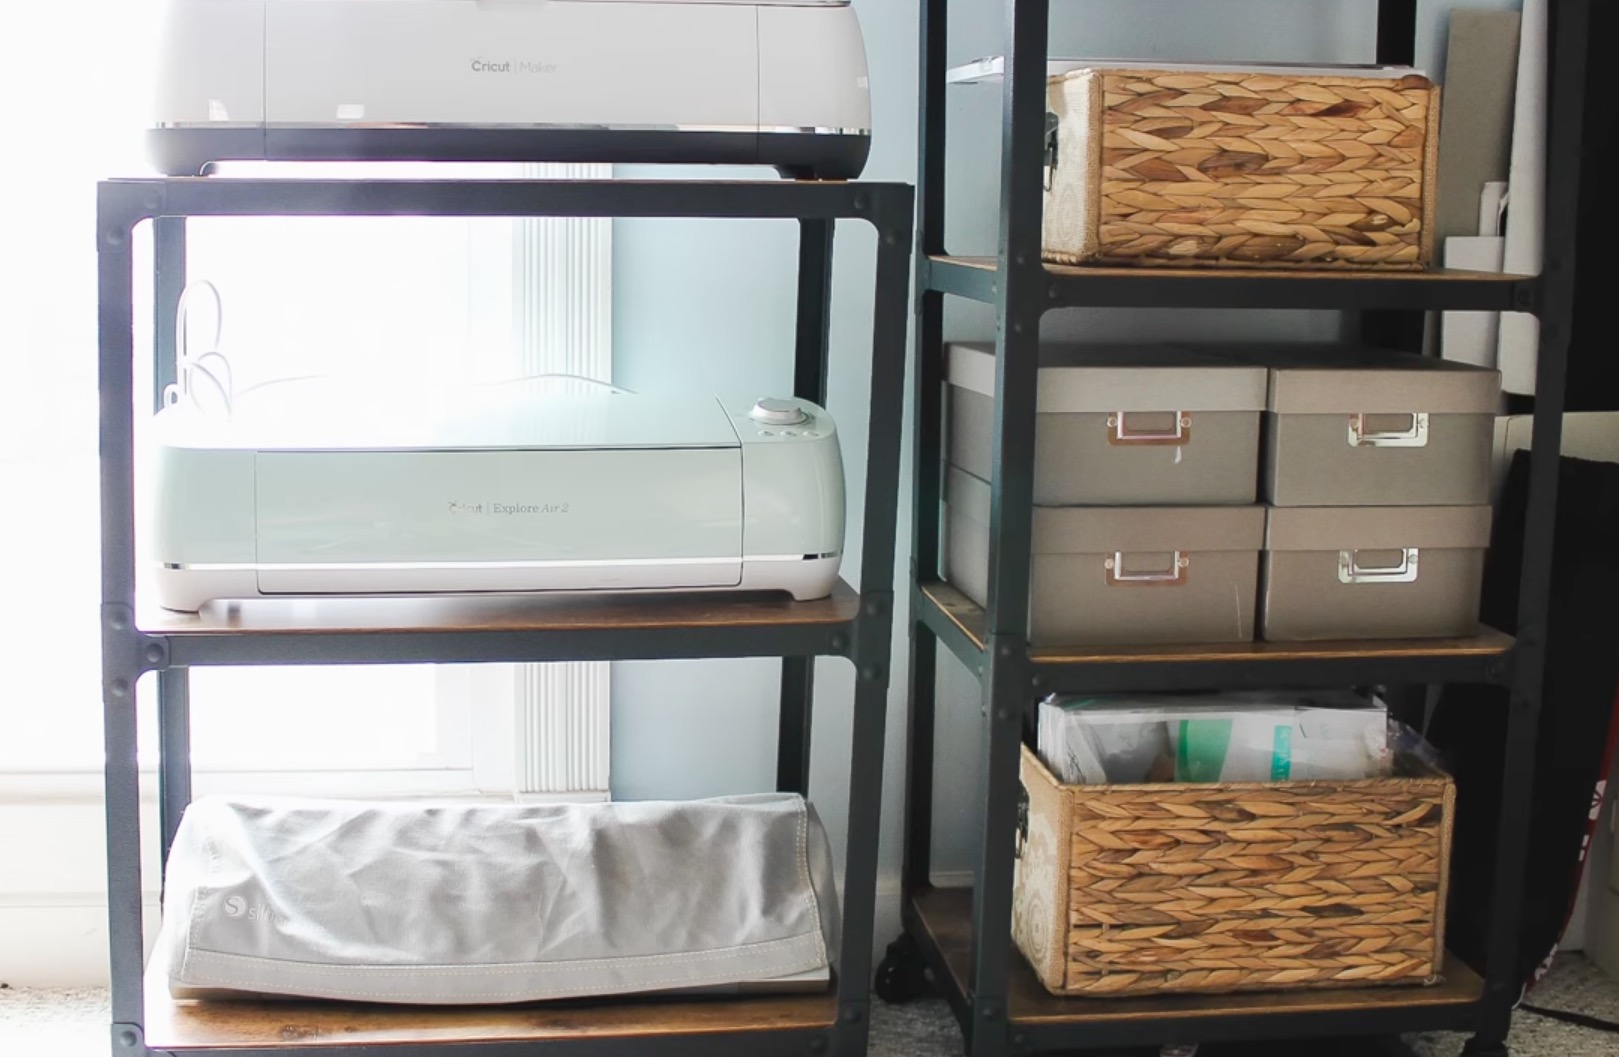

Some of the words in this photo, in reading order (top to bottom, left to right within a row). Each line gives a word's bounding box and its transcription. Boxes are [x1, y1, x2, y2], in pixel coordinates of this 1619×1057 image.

[470, 58, 510, 72] Cricut
[520, 61, 557, 73] Maker
[493, 502, 539, 515] Explore
[541, 503, 559, 513] Air
[561, 502, 569, 513] 2
